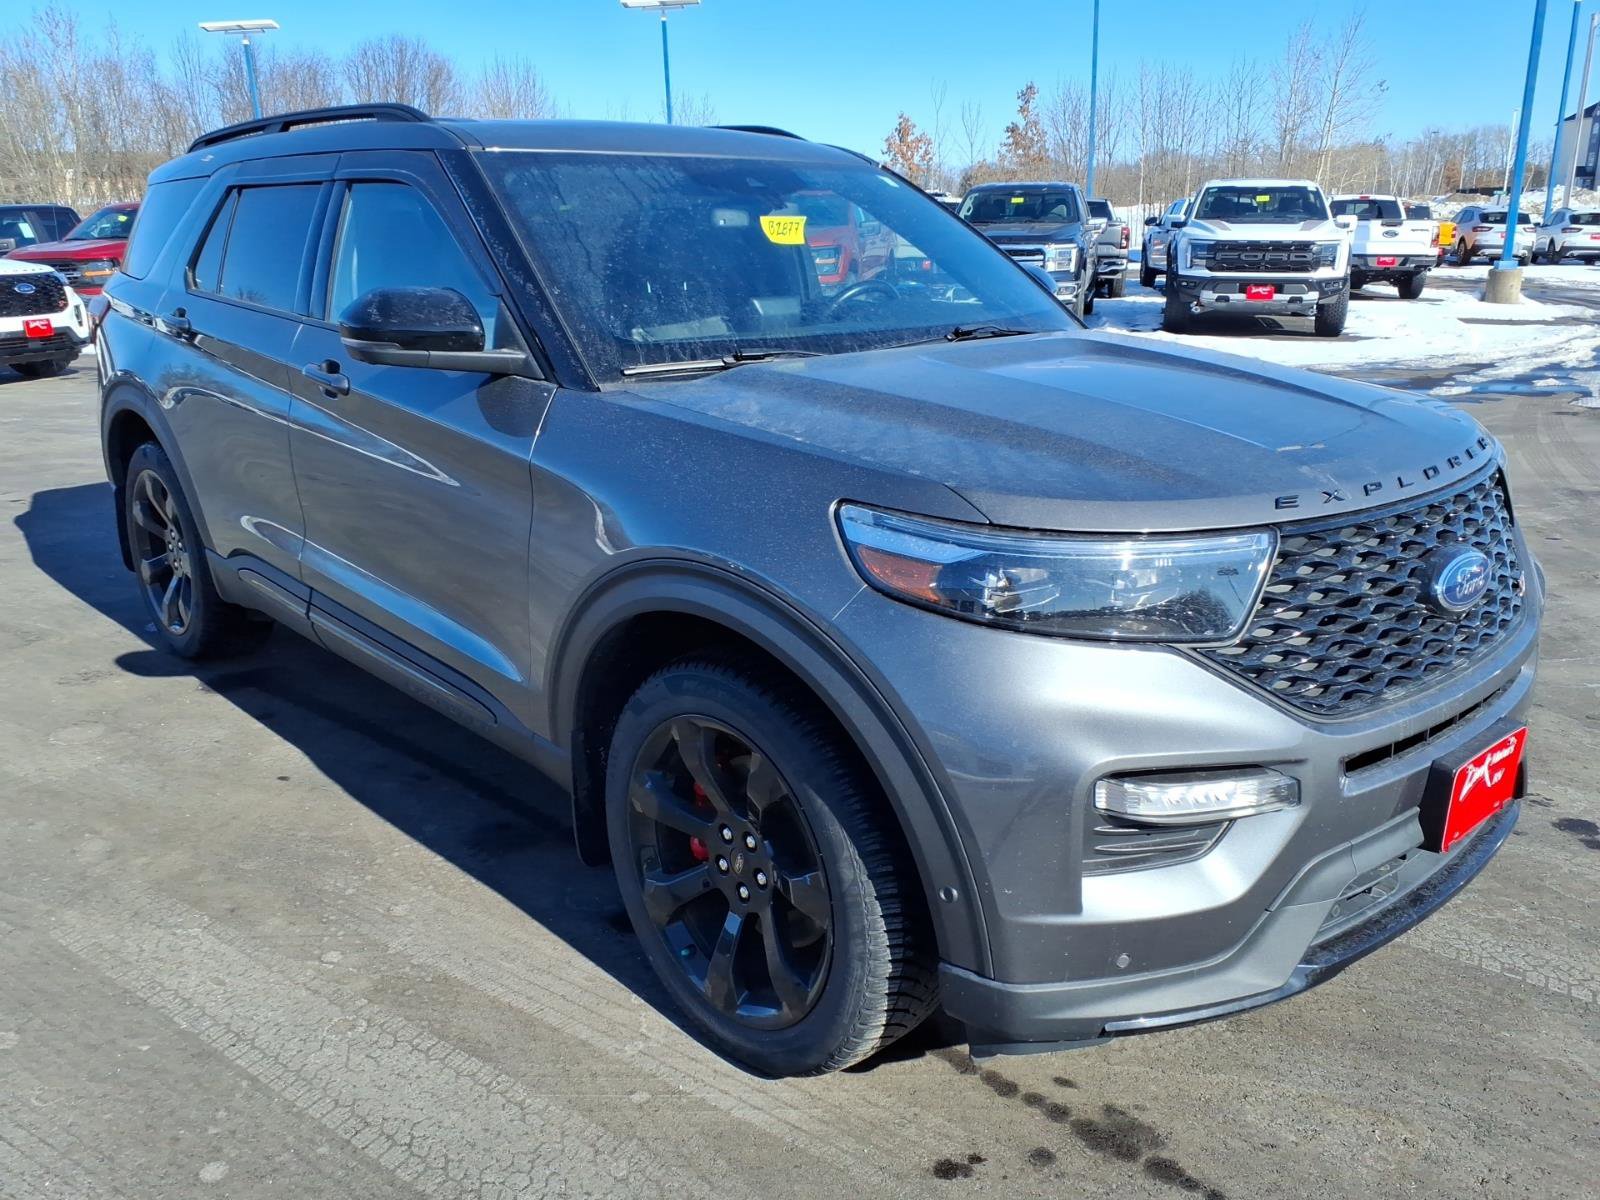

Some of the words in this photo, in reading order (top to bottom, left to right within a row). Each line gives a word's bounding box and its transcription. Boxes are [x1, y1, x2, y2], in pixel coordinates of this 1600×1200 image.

[1215, 251, 1314, 261] FORD
[1275, 436, 1490, 510] EXPLORER
[1455, 564, 1487, 598] Ford
